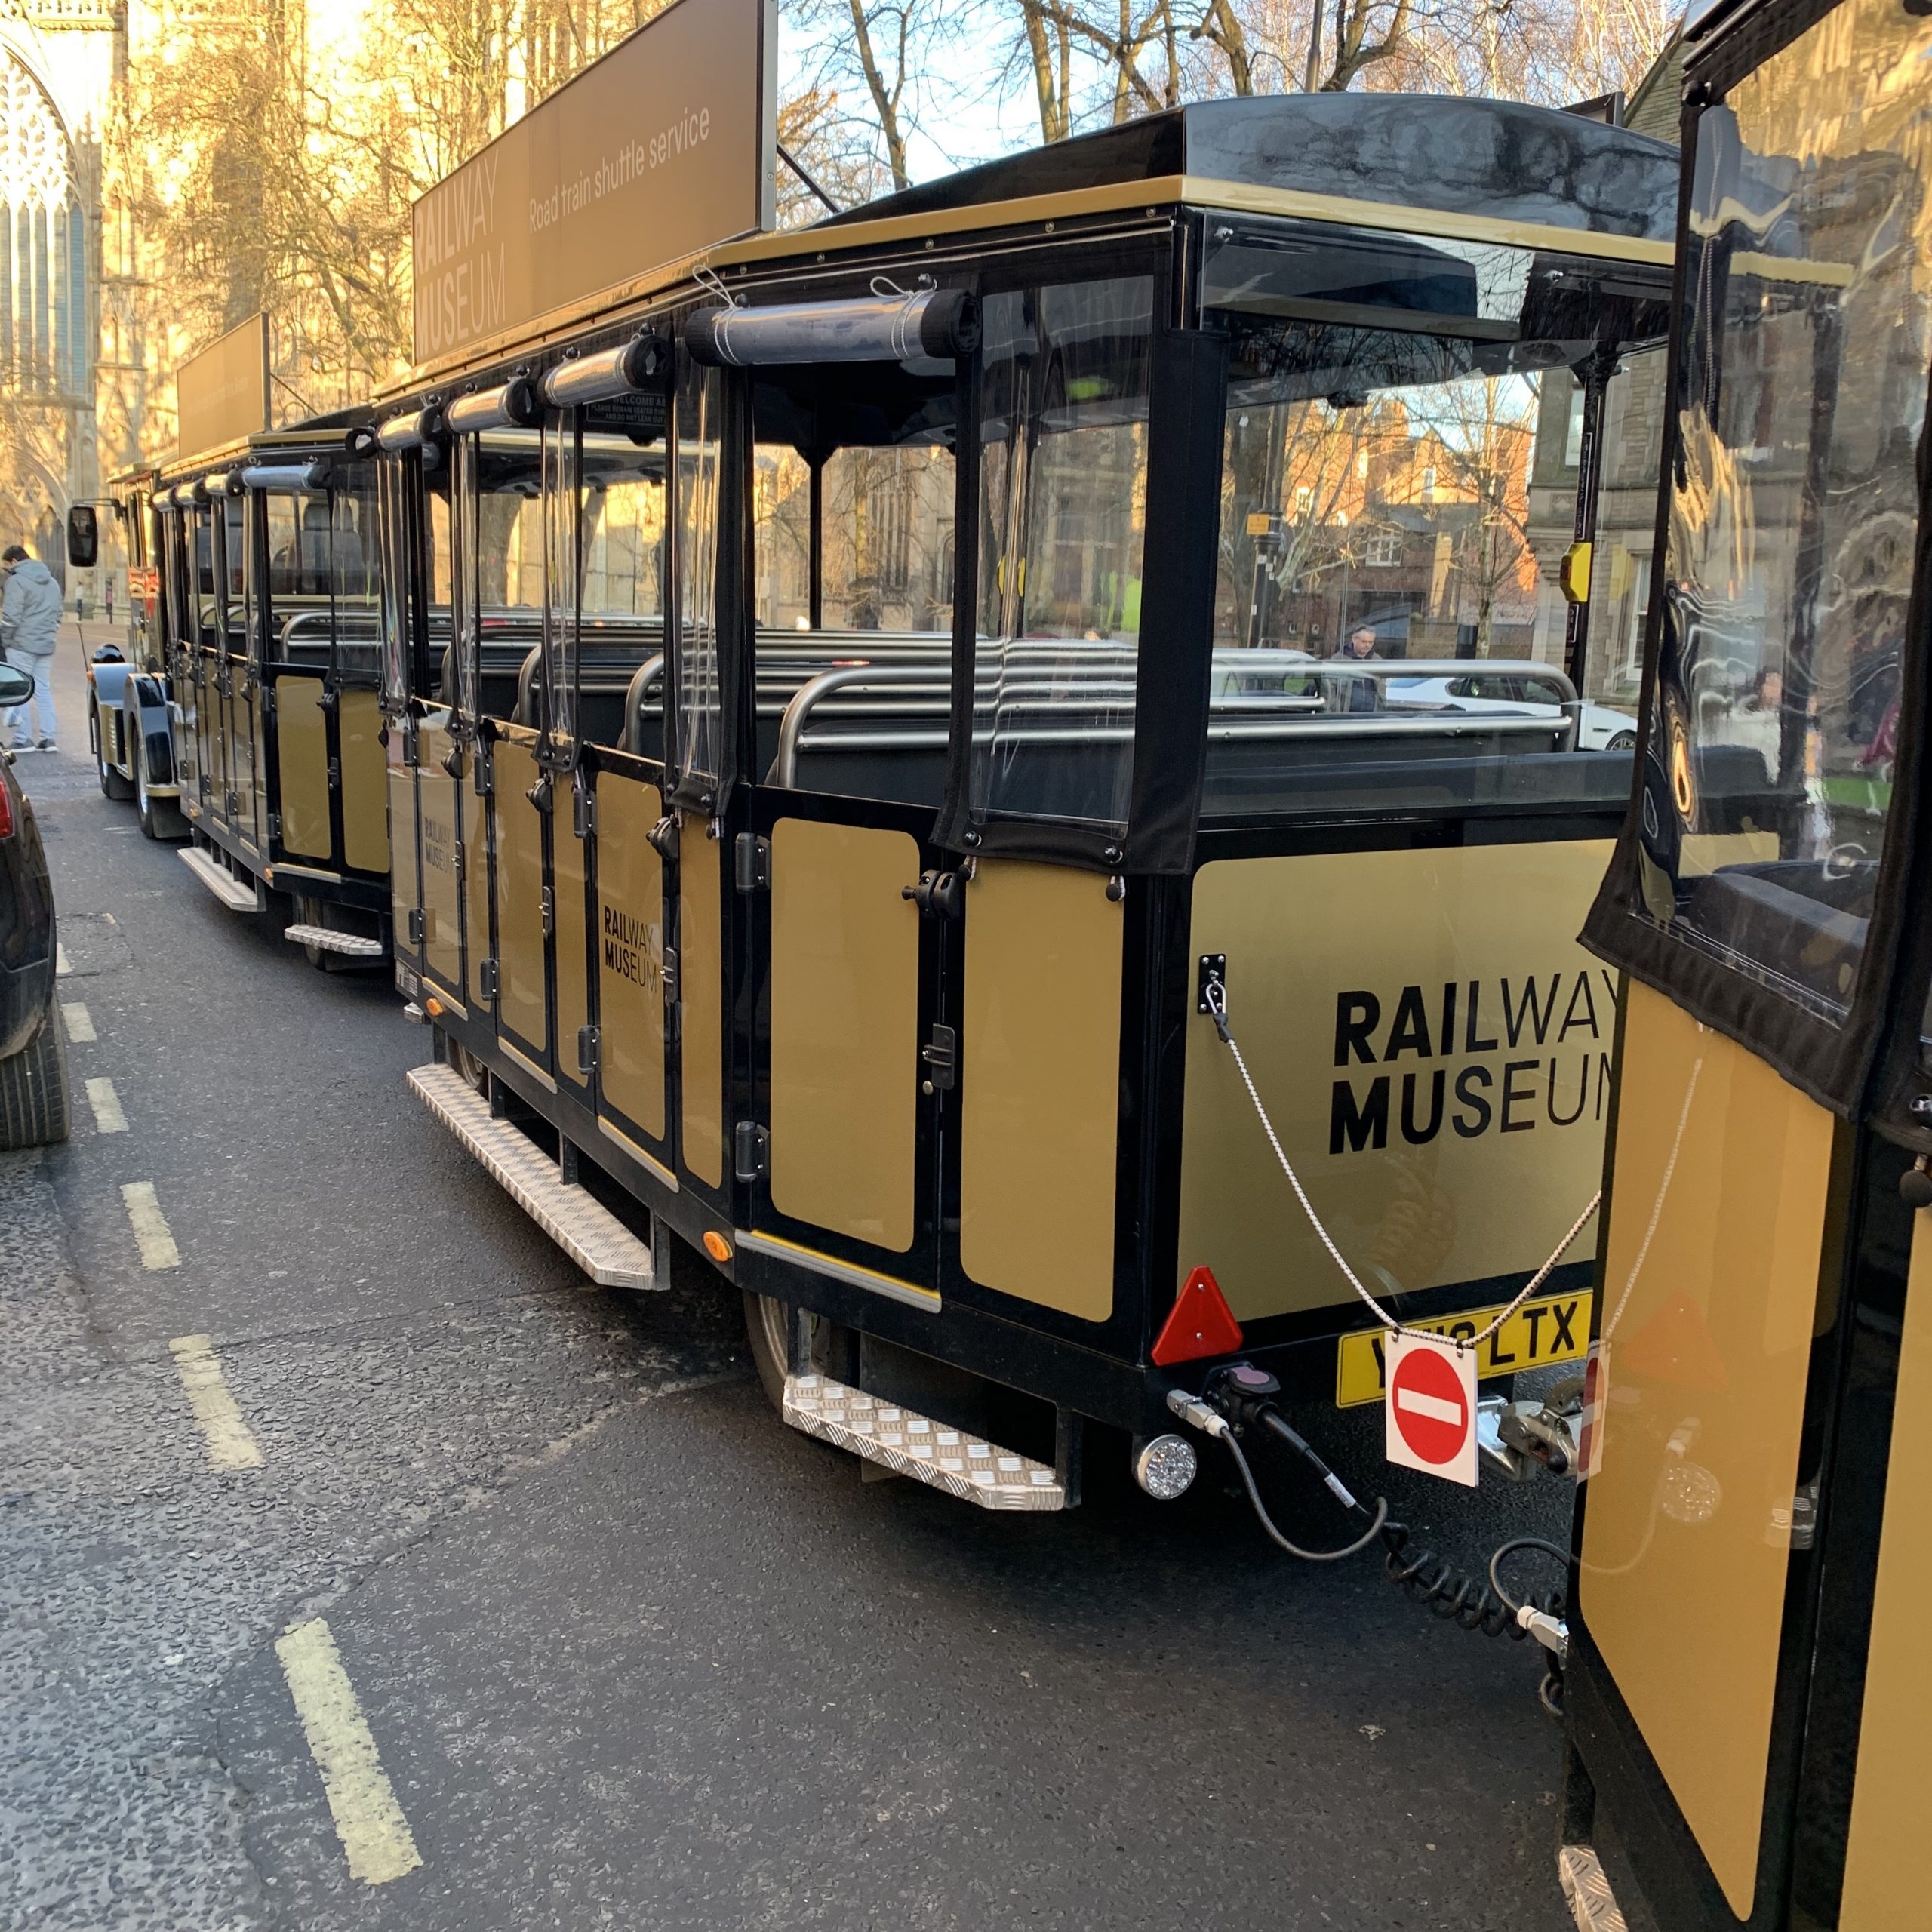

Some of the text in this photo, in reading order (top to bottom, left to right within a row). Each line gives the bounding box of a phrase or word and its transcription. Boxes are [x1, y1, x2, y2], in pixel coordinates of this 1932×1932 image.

[530, 107, 709, 234] Road train shuttle service
[416, 242, 506, 358] MUSEUM
[425, 817, 451, 848] RAILWAY
[604, 905, 654, 955] RAILWAY
[605, 938, 657, 994] MUSEUM
[1490, 1301, 1578, 1367] LTX
